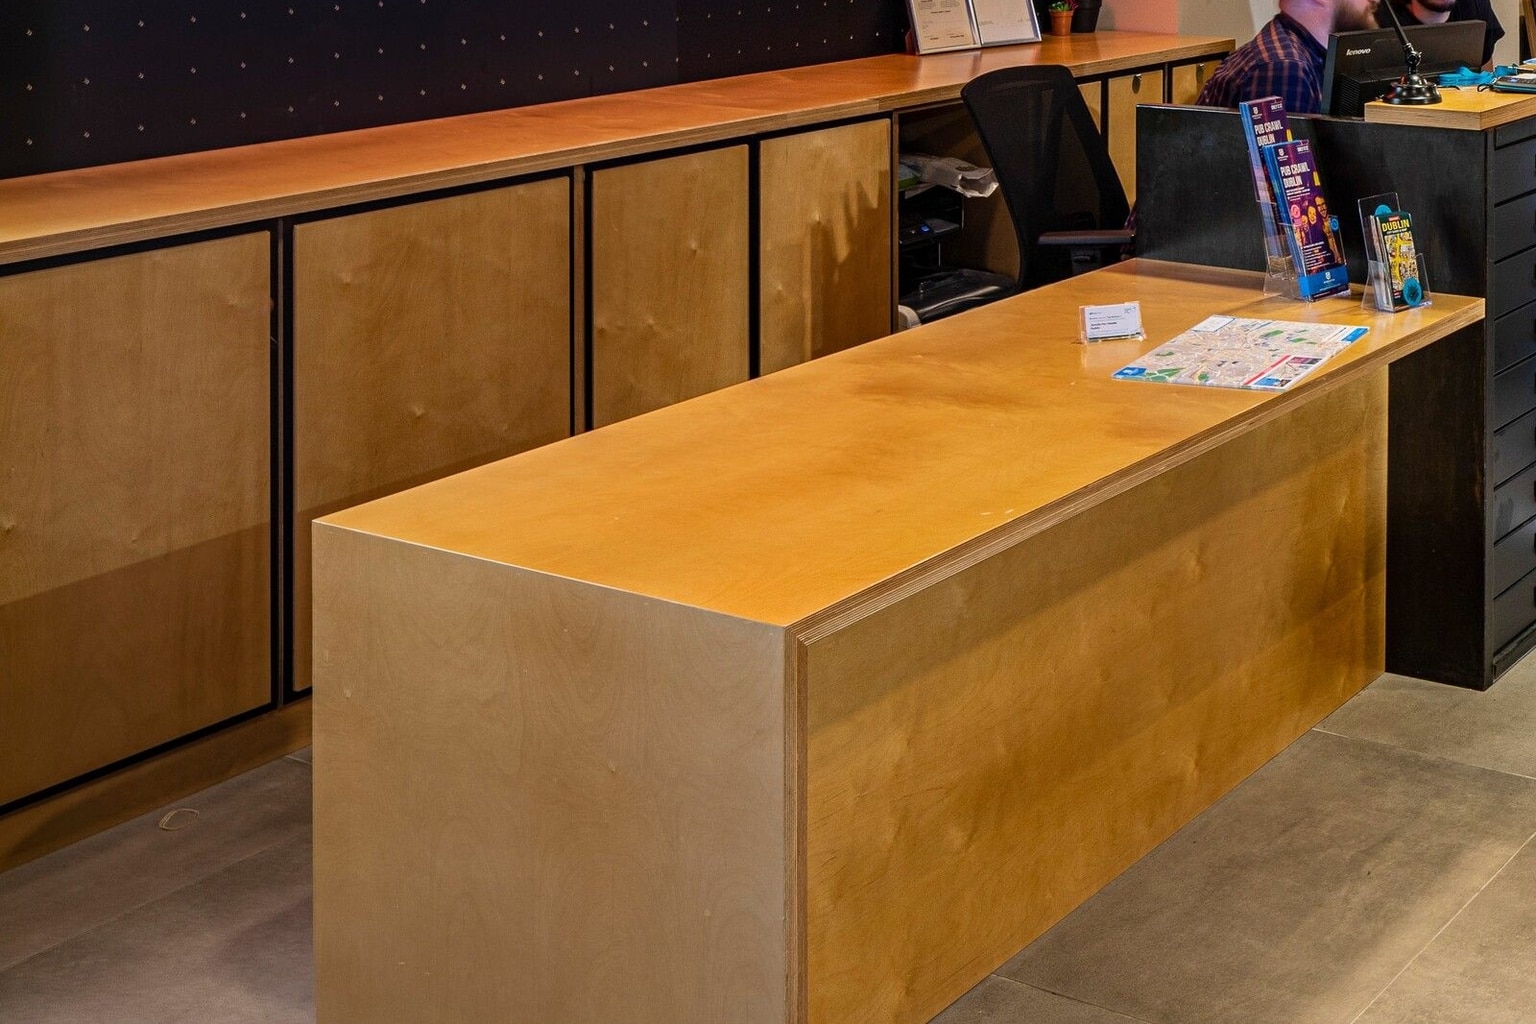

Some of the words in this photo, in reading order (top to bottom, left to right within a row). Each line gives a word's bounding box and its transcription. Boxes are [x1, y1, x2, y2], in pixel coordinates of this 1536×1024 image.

[1346, 48, 1371, 56] lenovo
[1254, 123, 1265, 135] PUB
[1264, 120, 1283, 132] CRAWL
[1257, 133, 1275, 146] DUBLIN
[1280, 164, 1292, 177] PUB
[1291, 161, 1310, 175] CRAWL
[1283, 175, 1303, 188] DUBLIN
[1381, 218, 1410, 233] DUBLIN
